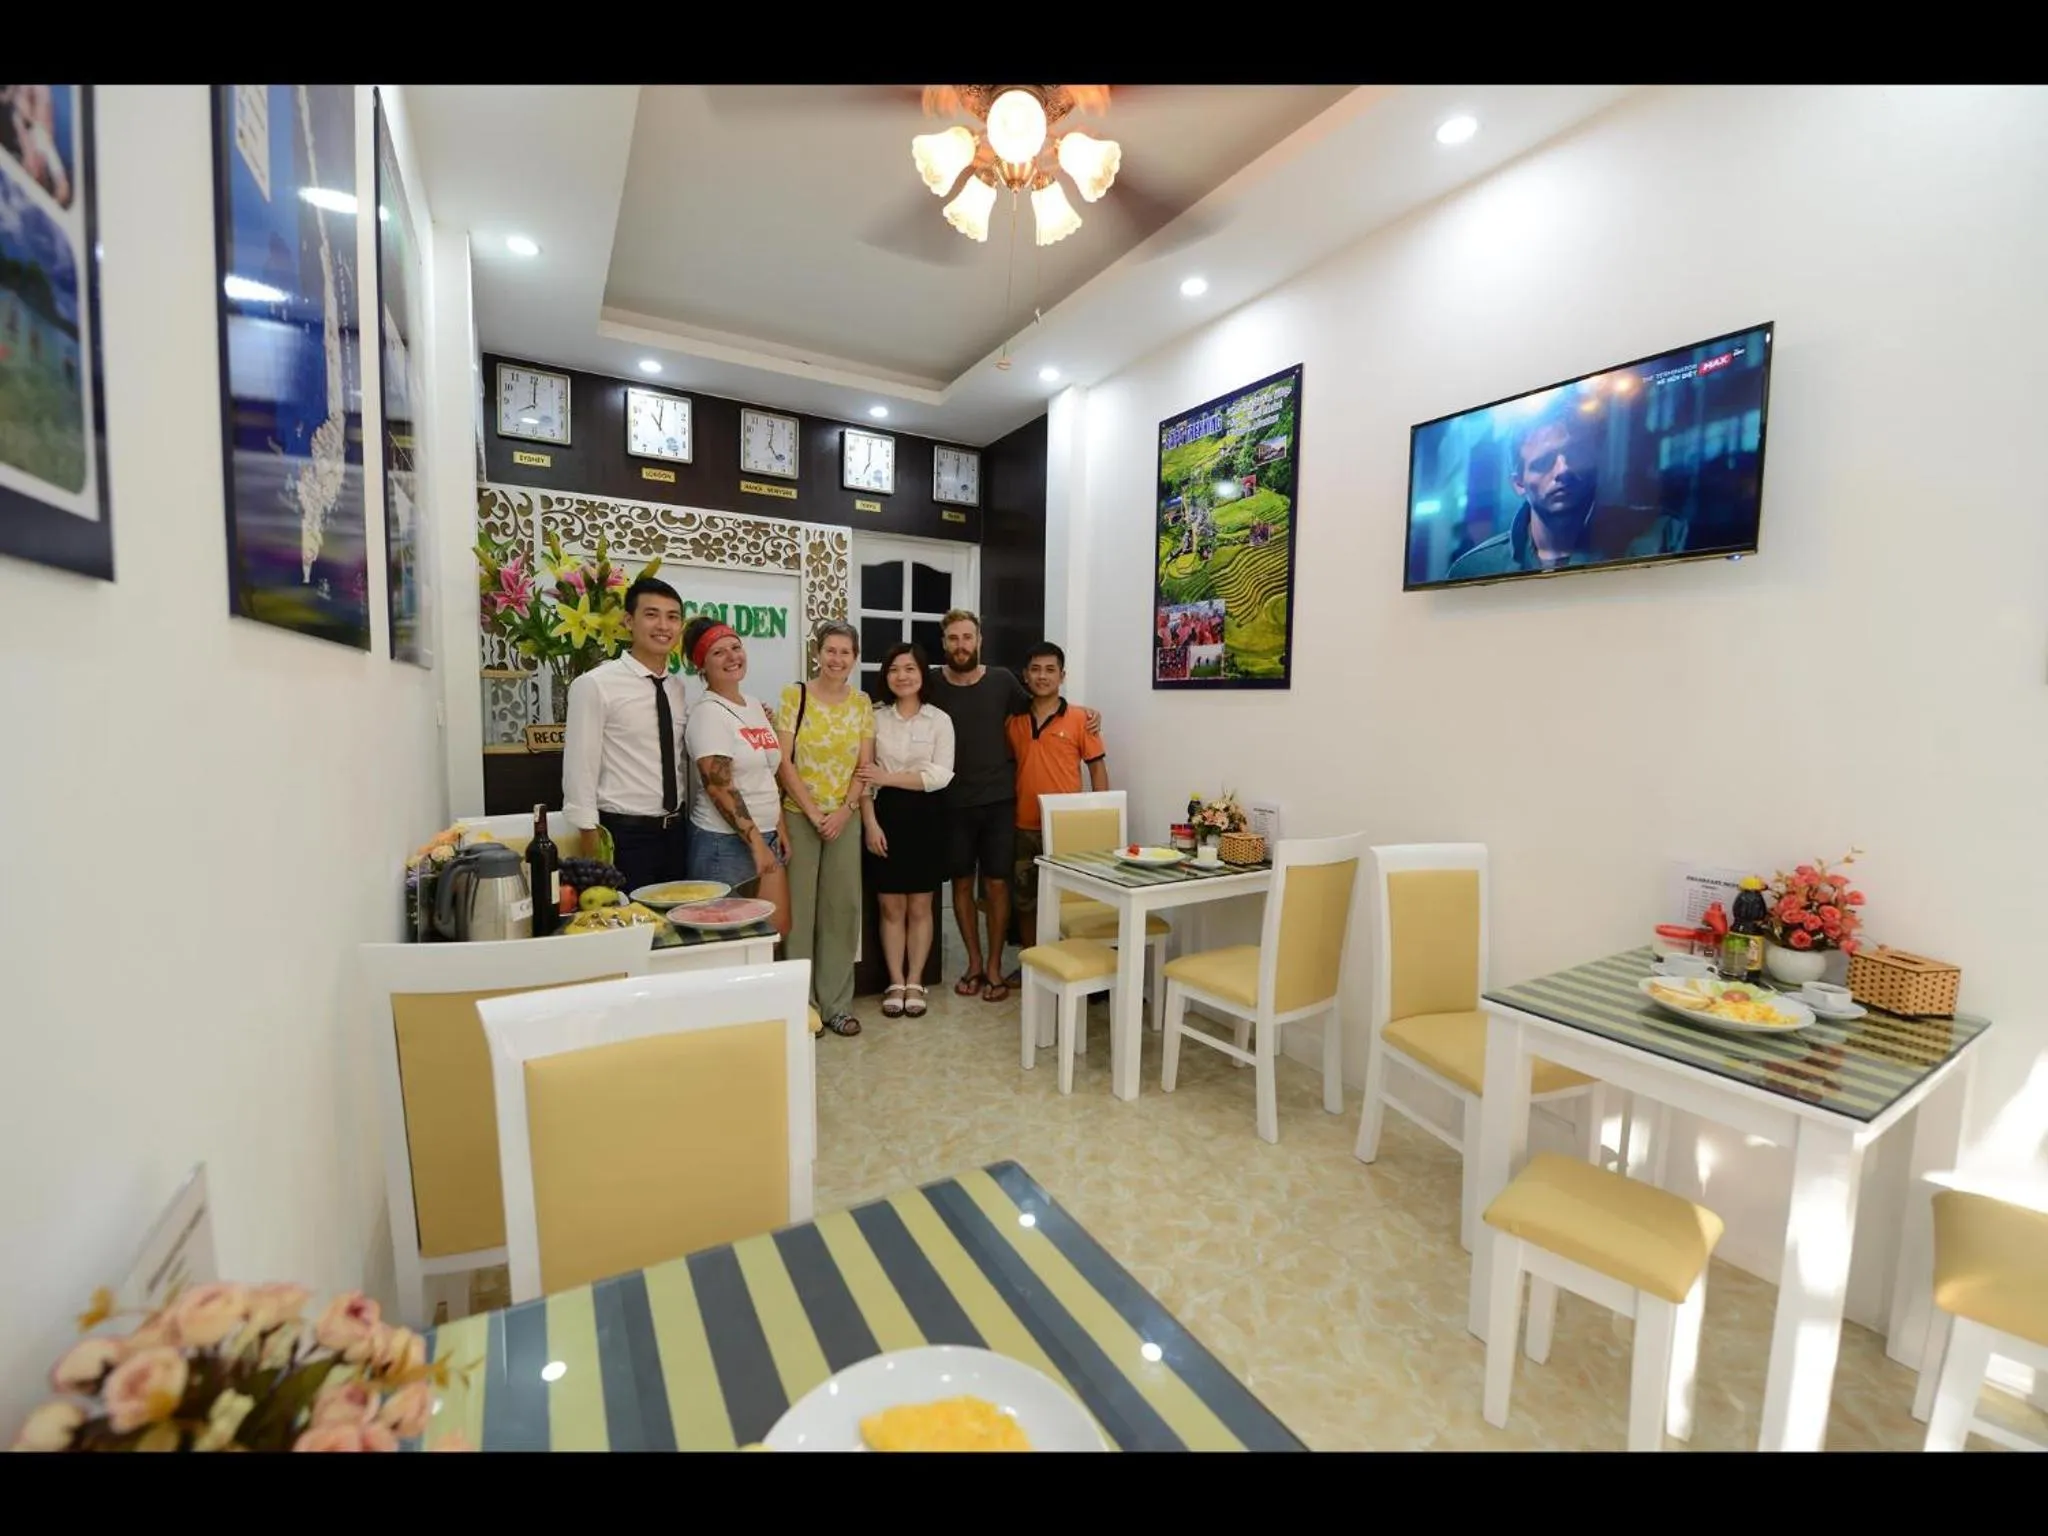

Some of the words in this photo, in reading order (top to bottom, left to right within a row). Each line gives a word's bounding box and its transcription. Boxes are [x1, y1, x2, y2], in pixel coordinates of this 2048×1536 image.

[1703, 355, 1731, 370] MAX
[511, 372, 519, 382] 11
[519, 454, 545, 464] SYDNEY
